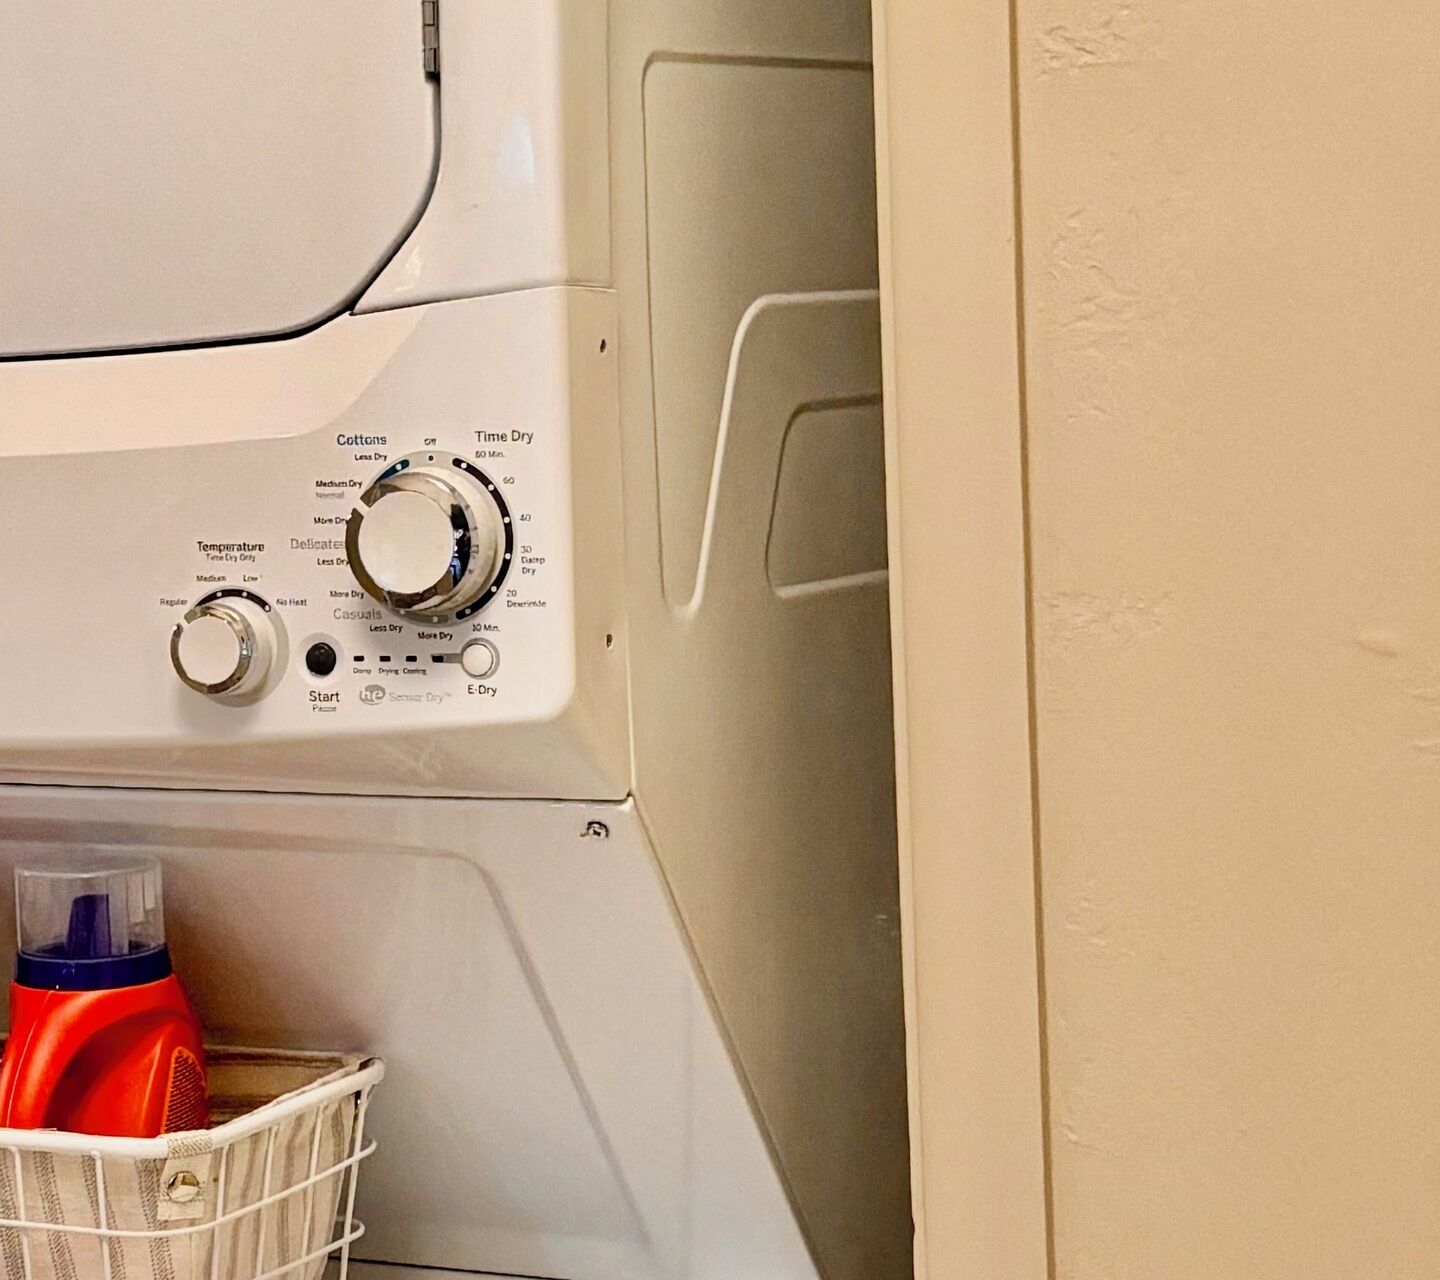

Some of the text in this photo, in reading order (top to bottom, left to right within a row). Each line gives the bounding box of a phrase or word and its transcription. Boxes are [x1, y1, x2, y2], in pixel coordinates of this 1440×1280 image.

[337, 434, 387, 446] Cottons
[474, 430, 534, 444] Time Dry
[354, 452, 388, 462] Less Dry
[349, 479, 363, 489] Dry
[314, 516, 334, 524] More
[197, 541, 265, 554] Temperature
[521, 545, 532, 553] 30
[225, 554, 238, 563] Dry
[240, 554, 256, 563] Only
[317, 558, 334, 566] Less
[522, 567, 536, 576] Dry
[243, 574, 258, 582] Low
[330, 590, 365, 599] More Dry
[160, 598, 188, 607] Regular
[276, 598, 308, 606] No Heat
[333, 608, 382, 620] Casuals
[370, 624, 403, 634] Less Dry
[418, 632, 453, 641] More Dry
[309, 690, 340, 703] Start
